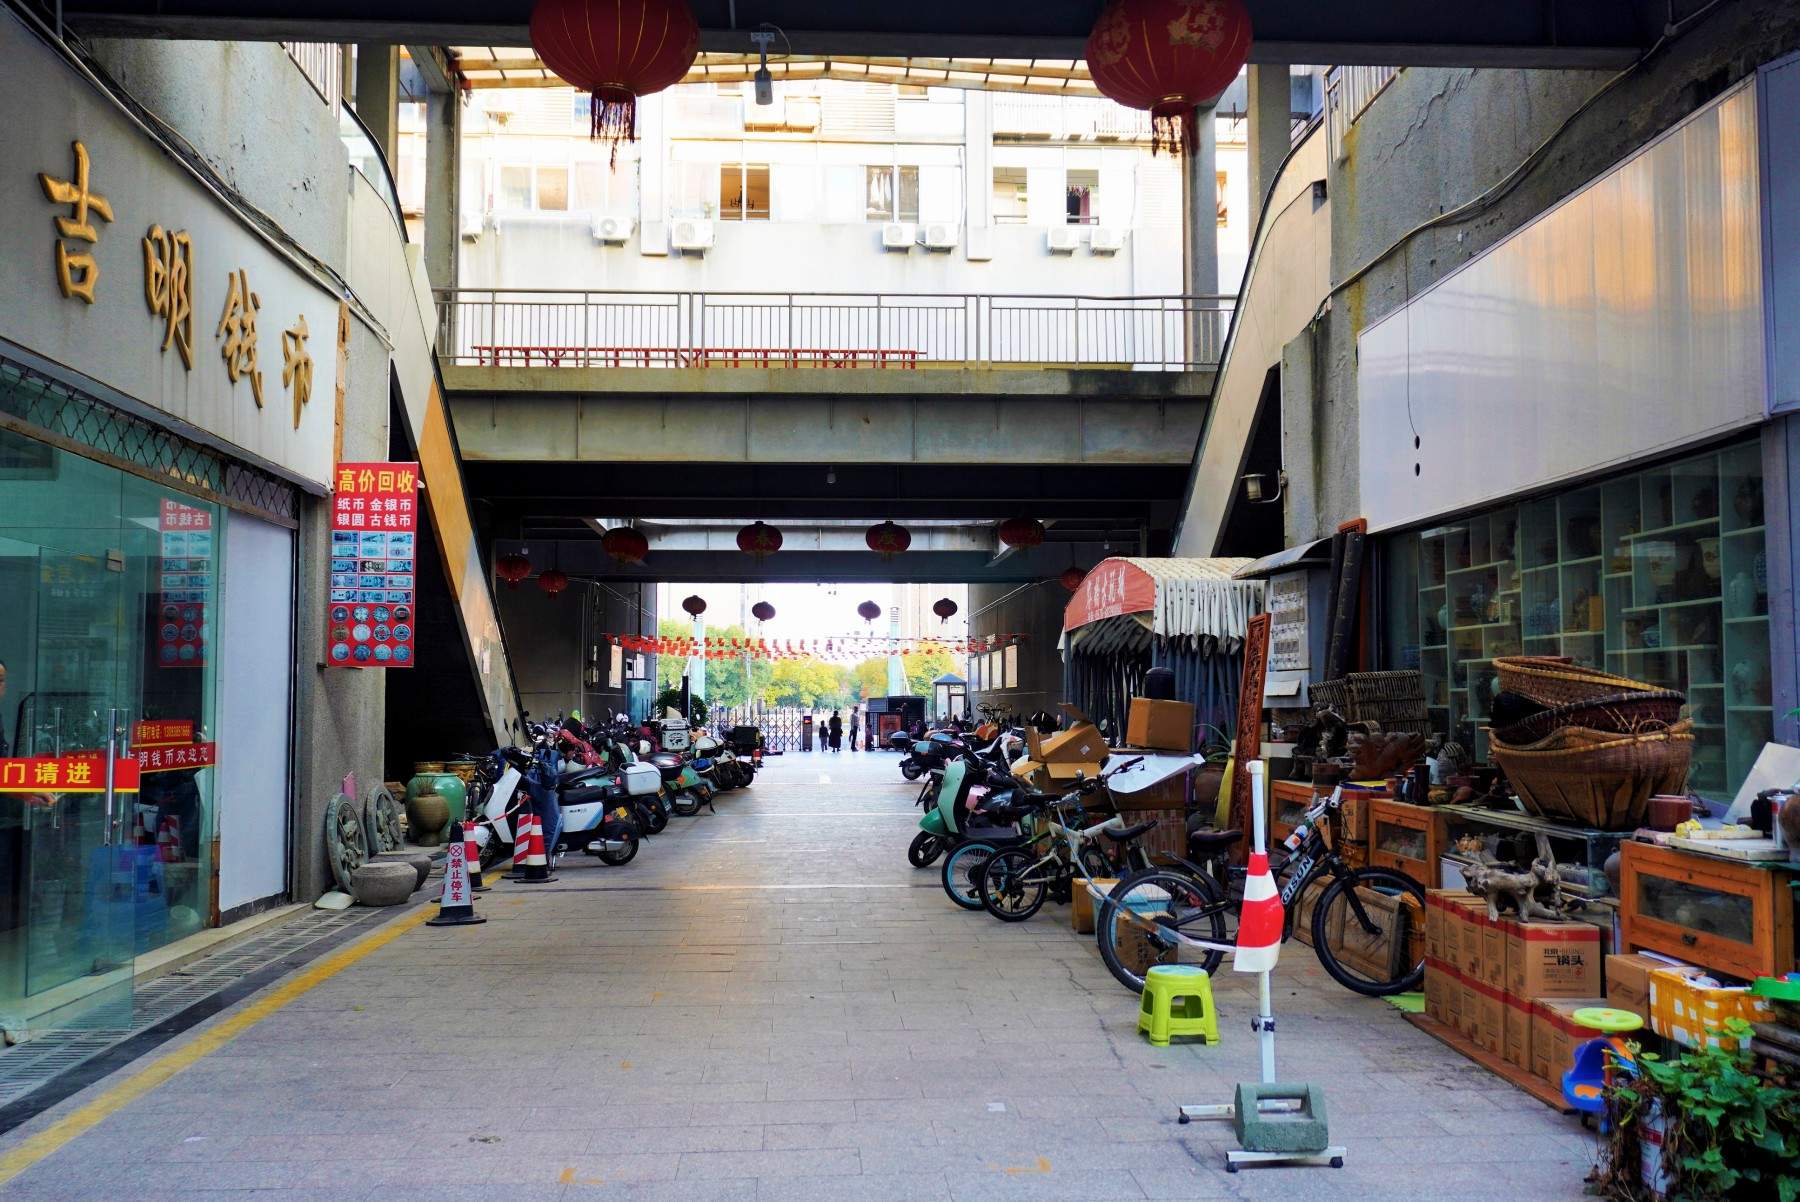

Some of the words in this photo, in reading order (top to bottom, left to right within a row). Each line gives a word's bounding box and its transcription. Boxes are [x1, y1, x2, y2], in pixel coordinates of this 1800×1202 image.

[338, 469, 414, 493] 高价回收
[337, 498, 365, 511] 纸币
[370, 498, 412, 512] 金银币
[337, 513, 365, 527] 银圆
[370, 514, 412, 527] 古钱币
[3, 762, 91, 784] 门请进
[450, 858, 463, 902] 禁止停车
